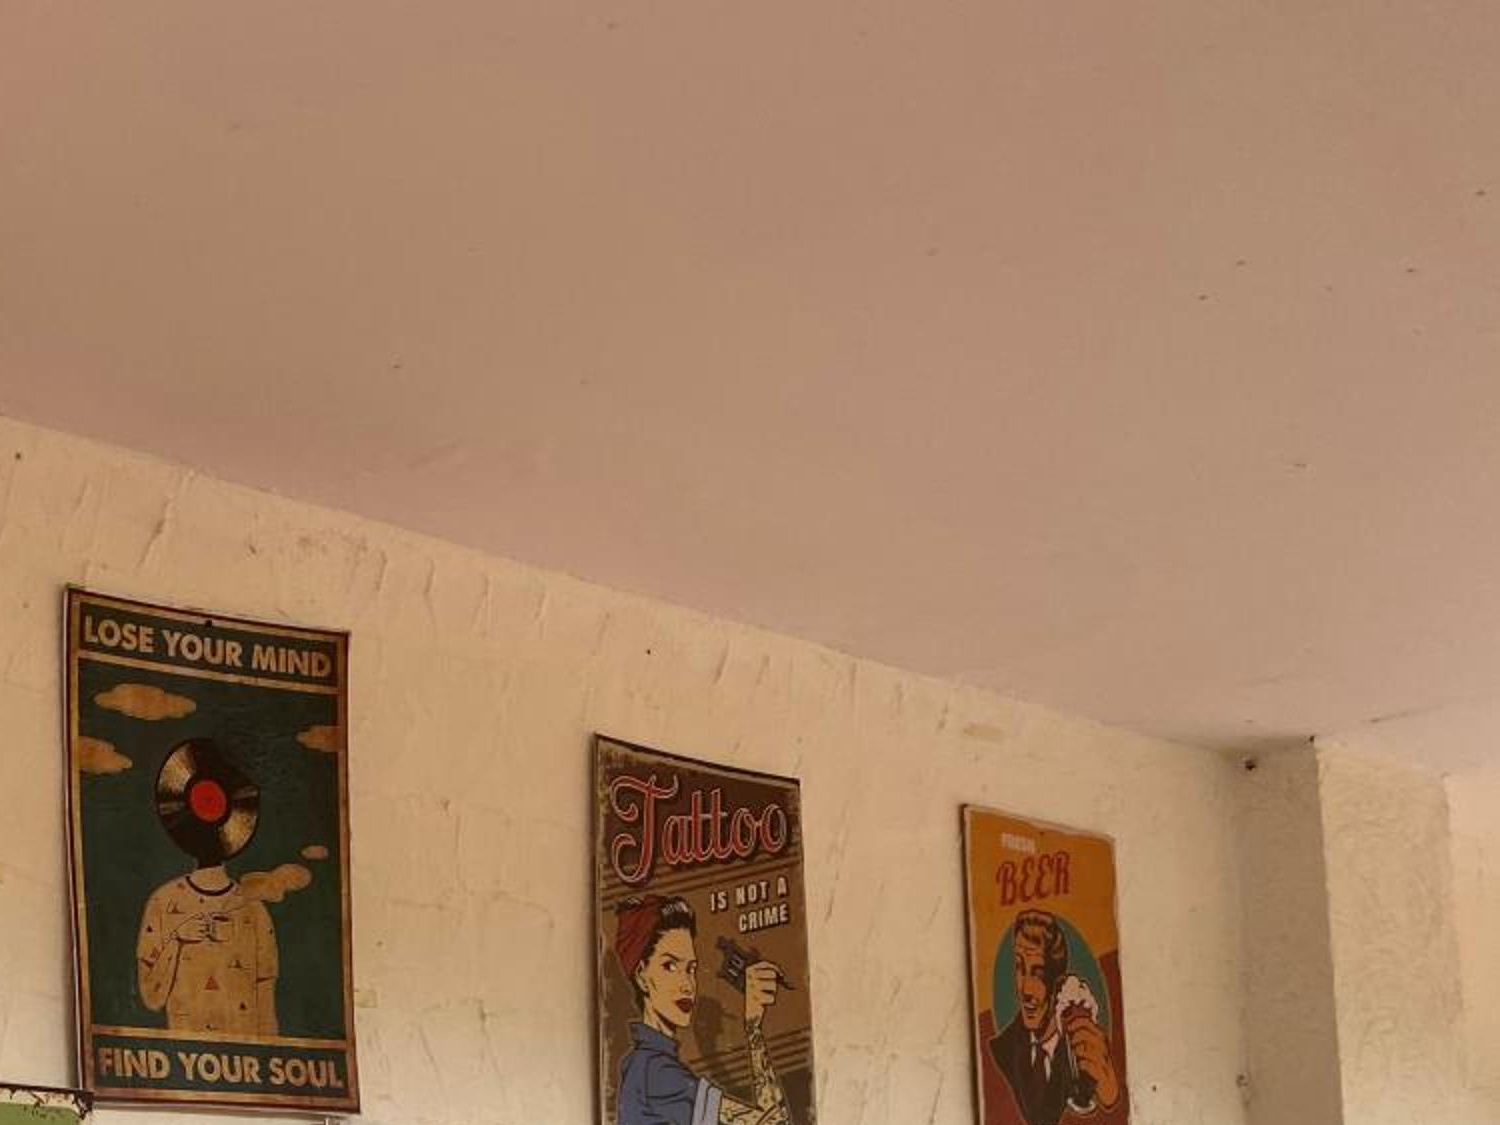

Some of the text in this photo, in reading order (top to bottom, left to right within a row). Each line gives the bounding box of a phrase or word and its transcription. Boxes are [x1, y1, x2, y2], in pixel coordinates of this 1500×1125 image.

[84, 615, 331, 677] LOSE YOUR MIND
[609, 774, 787, 883] Tattoo
[710, 877, 788, 912] IS NOT A
[996, 851, 1070, 907] BEER
[738, 904, 788, 932] CRIME
[98, 1047, 343, 1088] FIND YOUR SOUL
